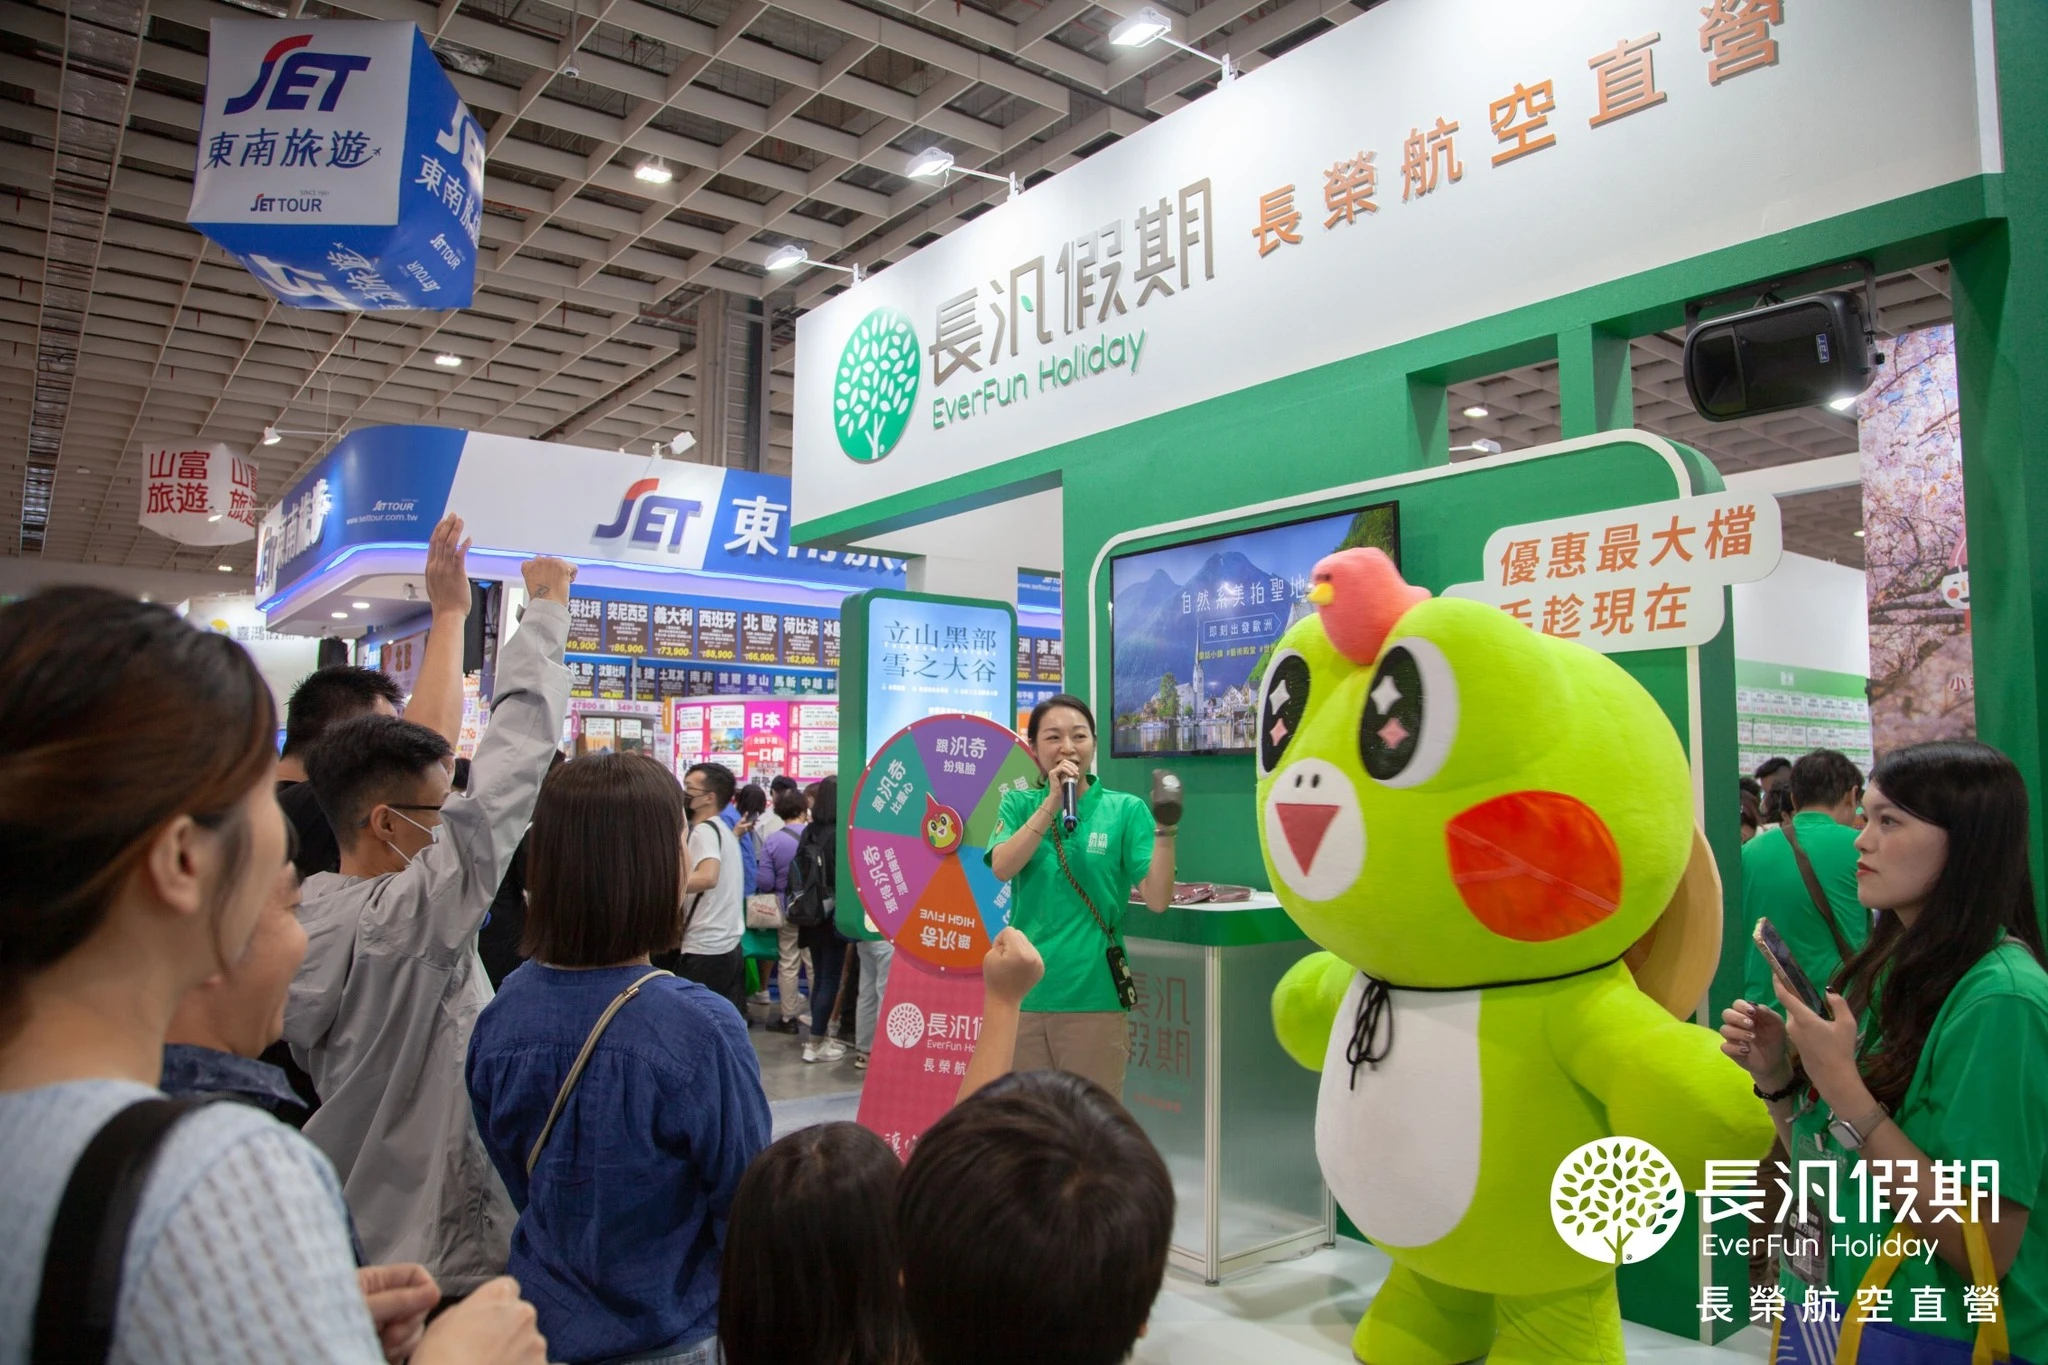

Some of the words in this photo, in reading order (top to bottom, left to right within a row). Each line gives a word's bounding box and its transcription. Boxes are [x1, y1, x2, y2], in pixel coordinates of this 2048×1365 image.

[1252, 0, 1782, 257] 長榮航空直營
[203, 127, 374, 169] 東南旅遊
[278, 198, 322, 212] TOUR
[441, 245, 460, 270] TOUR
[406, 260, 431, 283] TOUR
[929, 177, 1214, 387] 長汎假期
[932, 372, 1029, 431] EverFun
[1038, 329, 1148, 392] Holiday
[149, 450, 211, 479] 山富
[146, 482, 209, 514] 旅遊
[387, 502, 414, 511] TOUR
[1500, 504, 1756, 586] 優惠最大檔
[1182, 574, 1306, 614] 自然系美拍聖地
[568, 599, 602, 619] 萊杜拜
[607, 602, 648, 622] 突尼西亞
[654, 605, 693, 627] 義大利
[699, 610, 737, 630] 西班牙
[743, 613, 777, 632] 北歐
[783, 616, 819, 636] 荷比法
[1209, 618, 1274, 638] 即刻出發歐洲
[883, 620, 997, 652] 立山黑部
[659, 669, 685, 682] 土耳其
[882, 653, 998, 683] 雪之大谷
[750, 711, 781, 729] 日本
[935, 736, 988, 759] 跟汎奇
[943, 760, 976, 776] 扮鬼臉
[871, 759, 907, 813] 跟汎奇
[889, 782, 914, 816] 比愛心
[919, 908, 946, 922] FIVE
[947, 913, 976, 928] HIGH
[920, 925, 972, 951] 跟汎奇
[926, 1040, 962, 1051] EverFun
[923, 1057, 967, 1076] 長榮航
